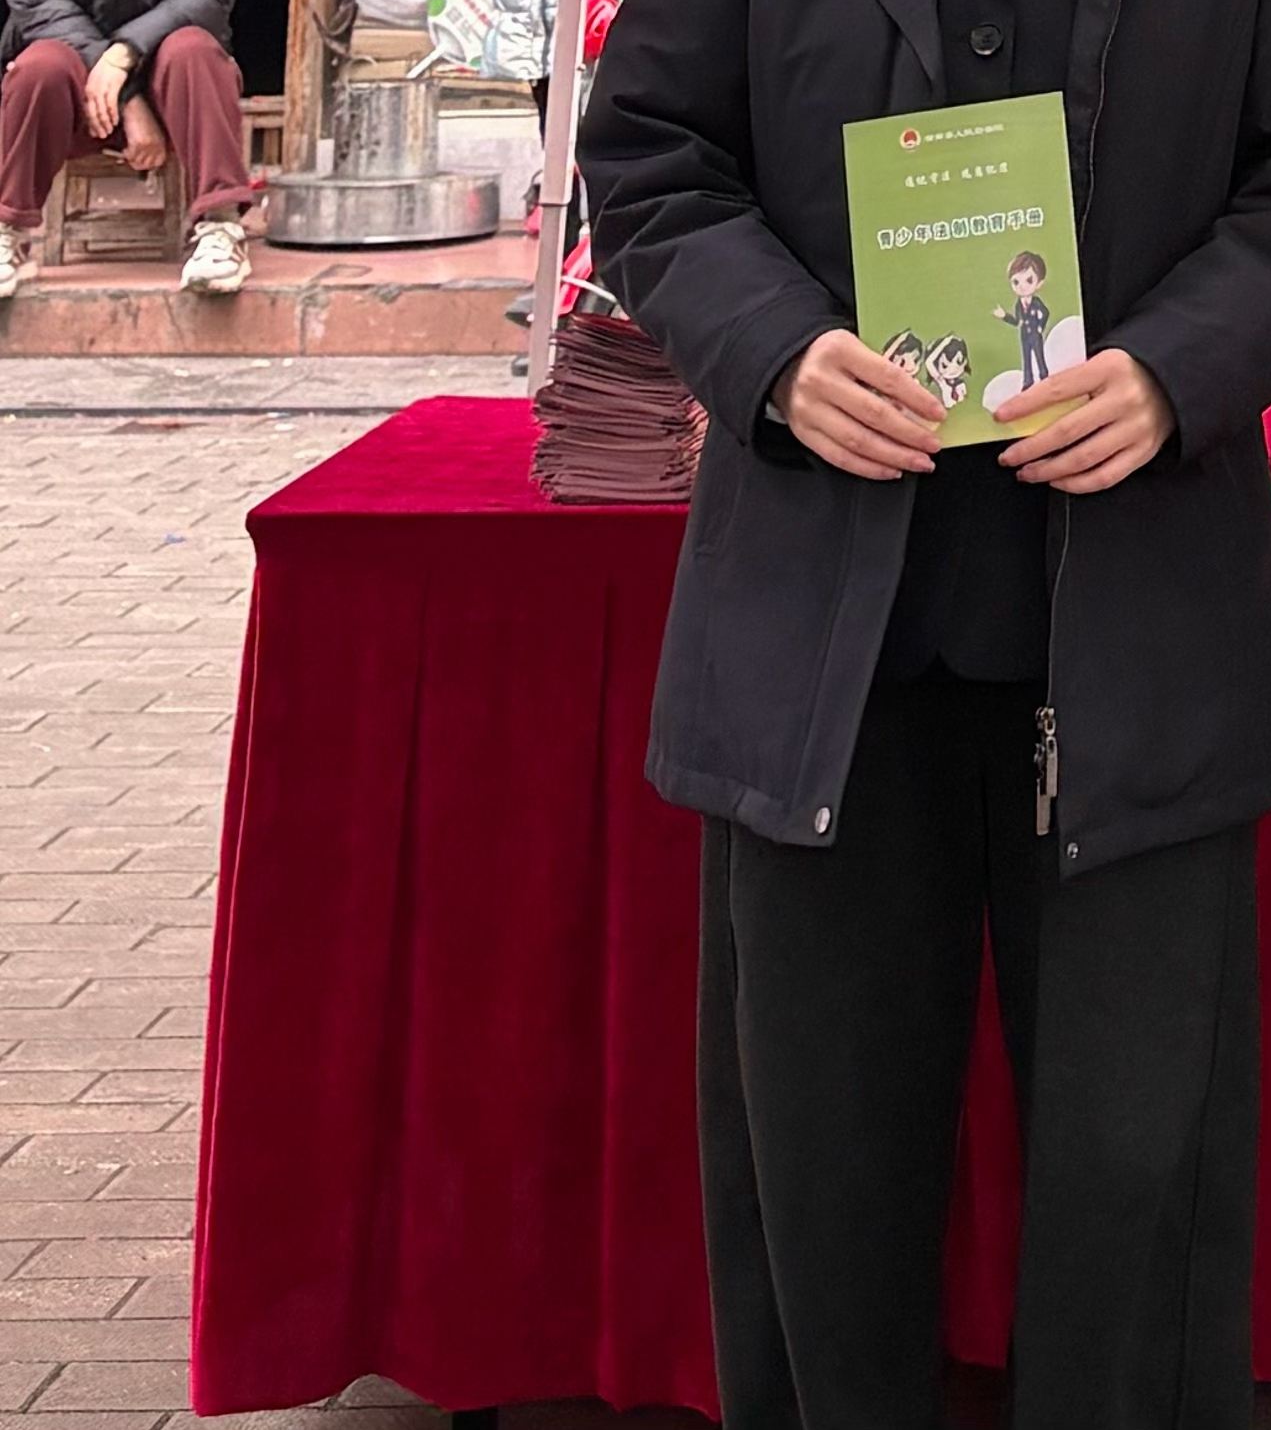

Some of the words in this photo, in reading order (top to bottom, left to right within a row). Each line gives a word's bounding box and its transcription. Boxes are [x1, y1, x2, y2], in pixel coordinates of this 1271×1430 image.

[877, 207, 1044, 250] 青少年法制教育手册
